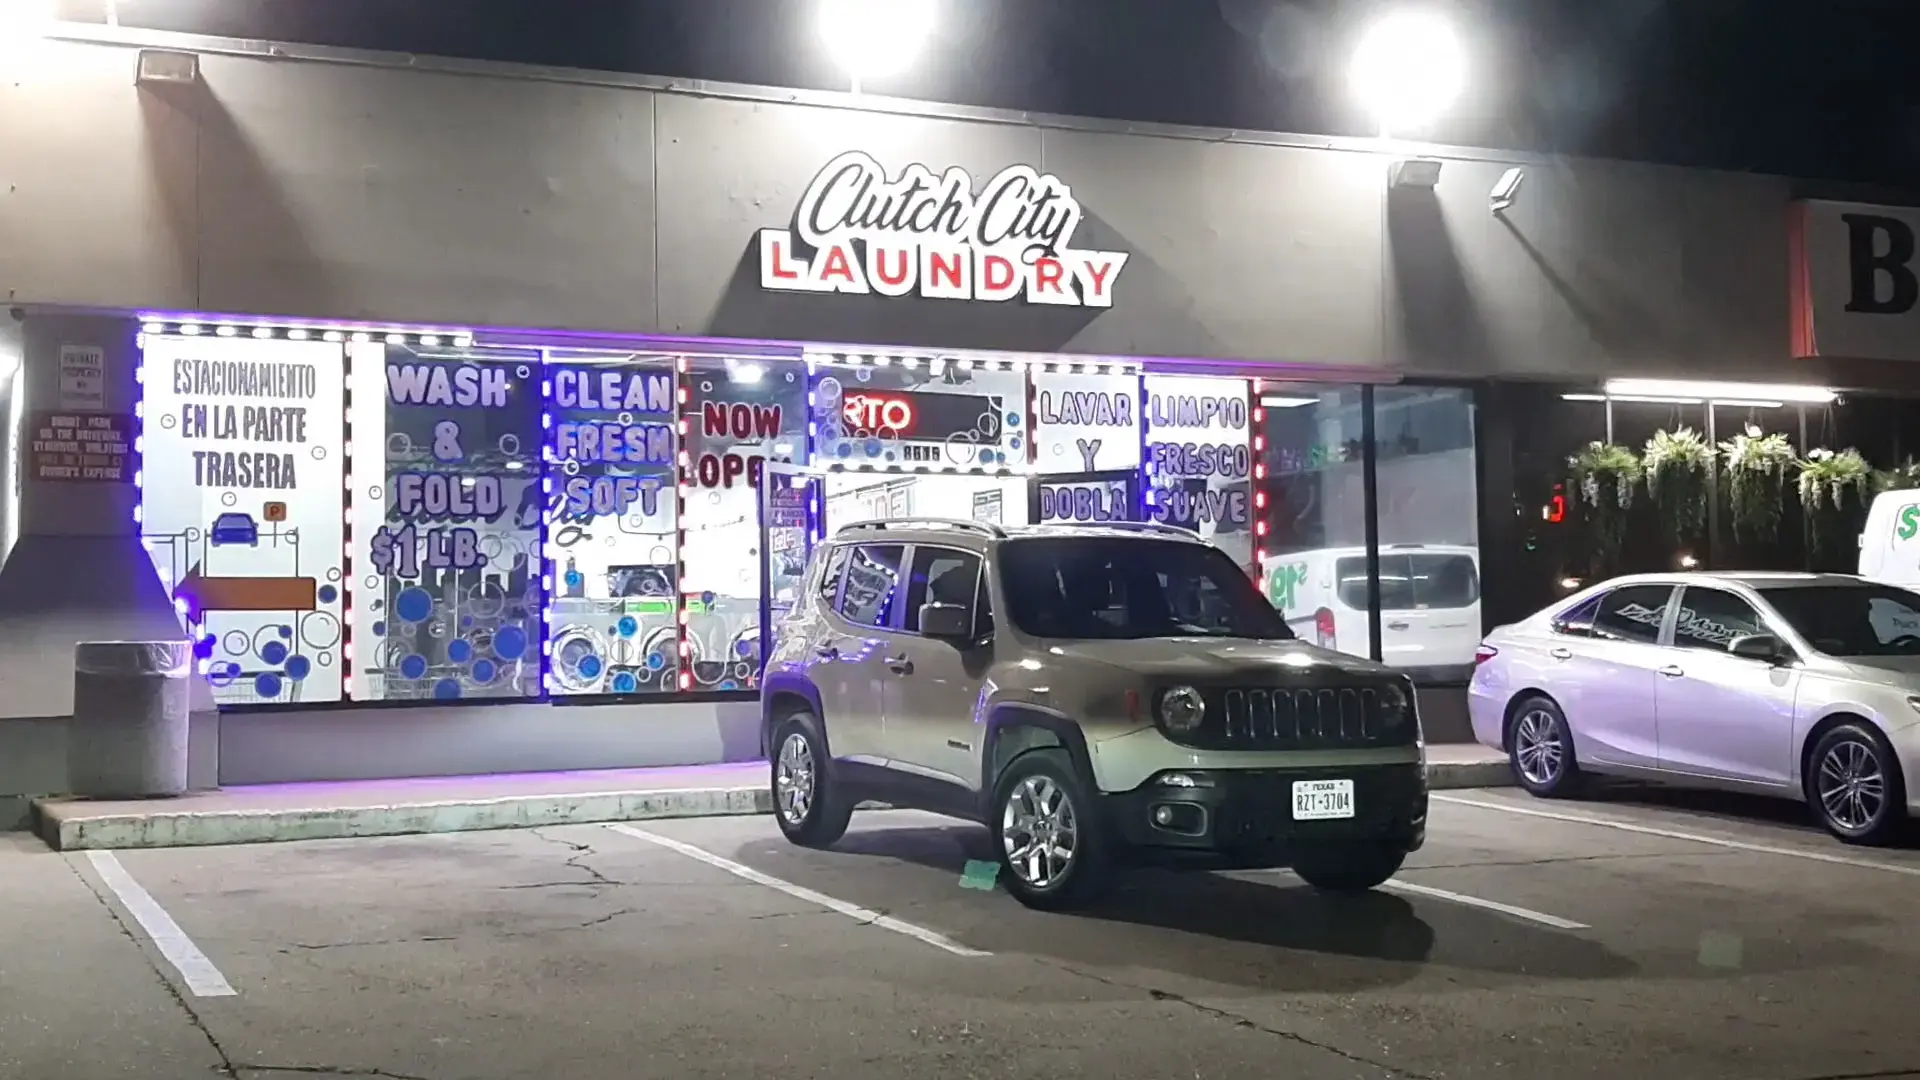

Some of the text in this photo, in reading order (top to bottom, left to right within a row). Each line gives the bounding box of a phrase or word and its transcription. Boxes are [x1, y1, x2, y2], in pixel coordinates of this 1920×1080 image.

[808, 162, 1071, 265] Clutch City
[771, 240, 1112, 296] LAUNDRY
[173, 358, 316, 399] ESTACIONAMIENTO
[386, 363, 507, 408] WASH
[554, 369, 671, 413] CLEAN
[182, 403, 307, 443] EN LA PARTE
[702, 401, 782, 440] NOW
[1040, 390, 1133, 427] LAVAR
[1151, 394, 1247, 429] LIMPIO
[433, 419, 465, 462] &
[556, 423, 673, 463] FRESH
[1076, 438, 1102, 472] Y
[1150, 442, 1249, 477] FRESCO
[192, 451, 297, 489] TRASERA
[397, 473, 502, 517] FOLD
[566, 476, 662, 517] SOFT
[1041, 487, 1128, 521] DOBLA
[1153, 489, 1248, 523] SUAVE
[370, 525, 488, 578] $1 LB.
[1312, 783, 1335, 791] TEXAS
